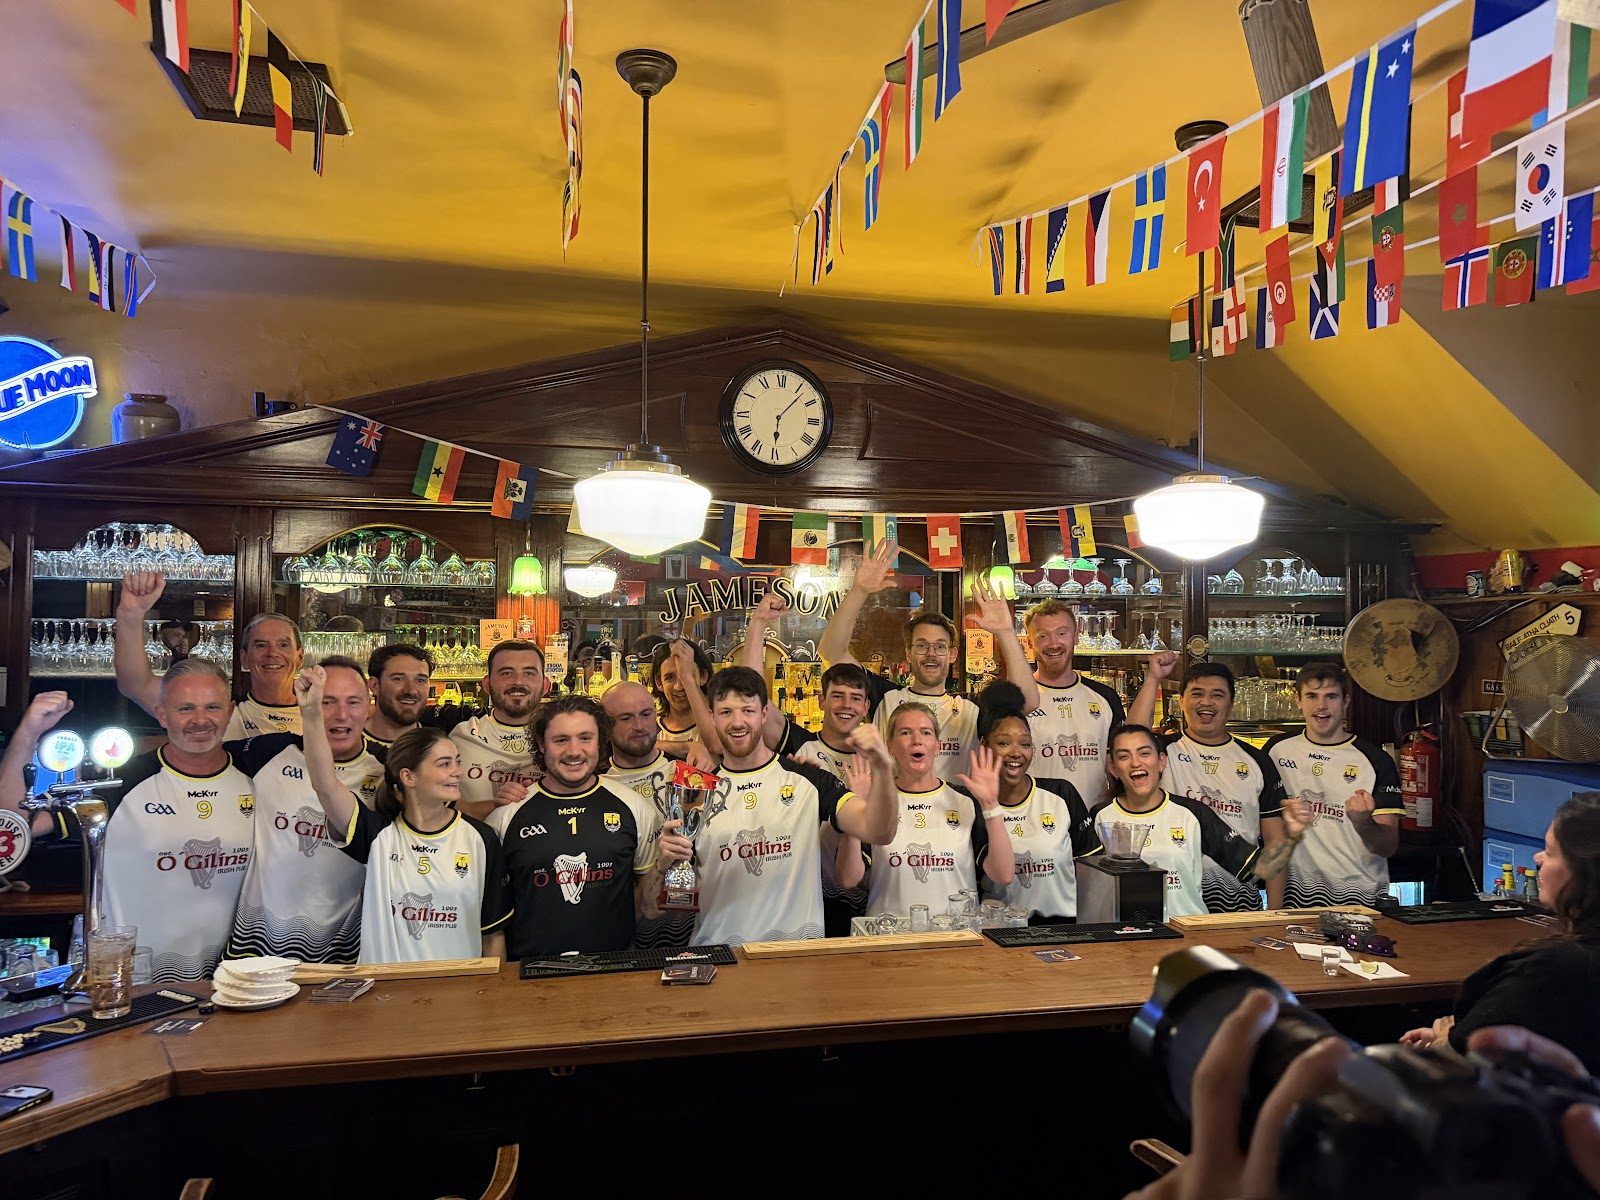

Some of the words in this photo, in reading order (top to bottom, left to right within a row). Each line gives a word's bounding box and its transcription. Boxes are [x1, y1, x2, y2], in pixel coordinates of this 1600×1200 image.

[24, 363, 91, 402] MOON
[659, 576, 843, 624] JAMESON
[1539, 613, 1560, 631] CLIATH
[1564, 611, 1576, 625] 5
[1057, 704, 1073, 718] 11
[55, 741, 75, 752] IPA
[499, 738, 526, 753] 20
[1201, 761, 1218, 775] 17
[1311, 762, 1323, 776] 6
[744, 792, 758, 810] 9
[196, 800, 213, 820] 9
[567, 816, 578, 835] 1
[914, 812, 926, 829] 3
[1011, 824, 1024, 837] 4
[417, 856, 431, 875] 5
